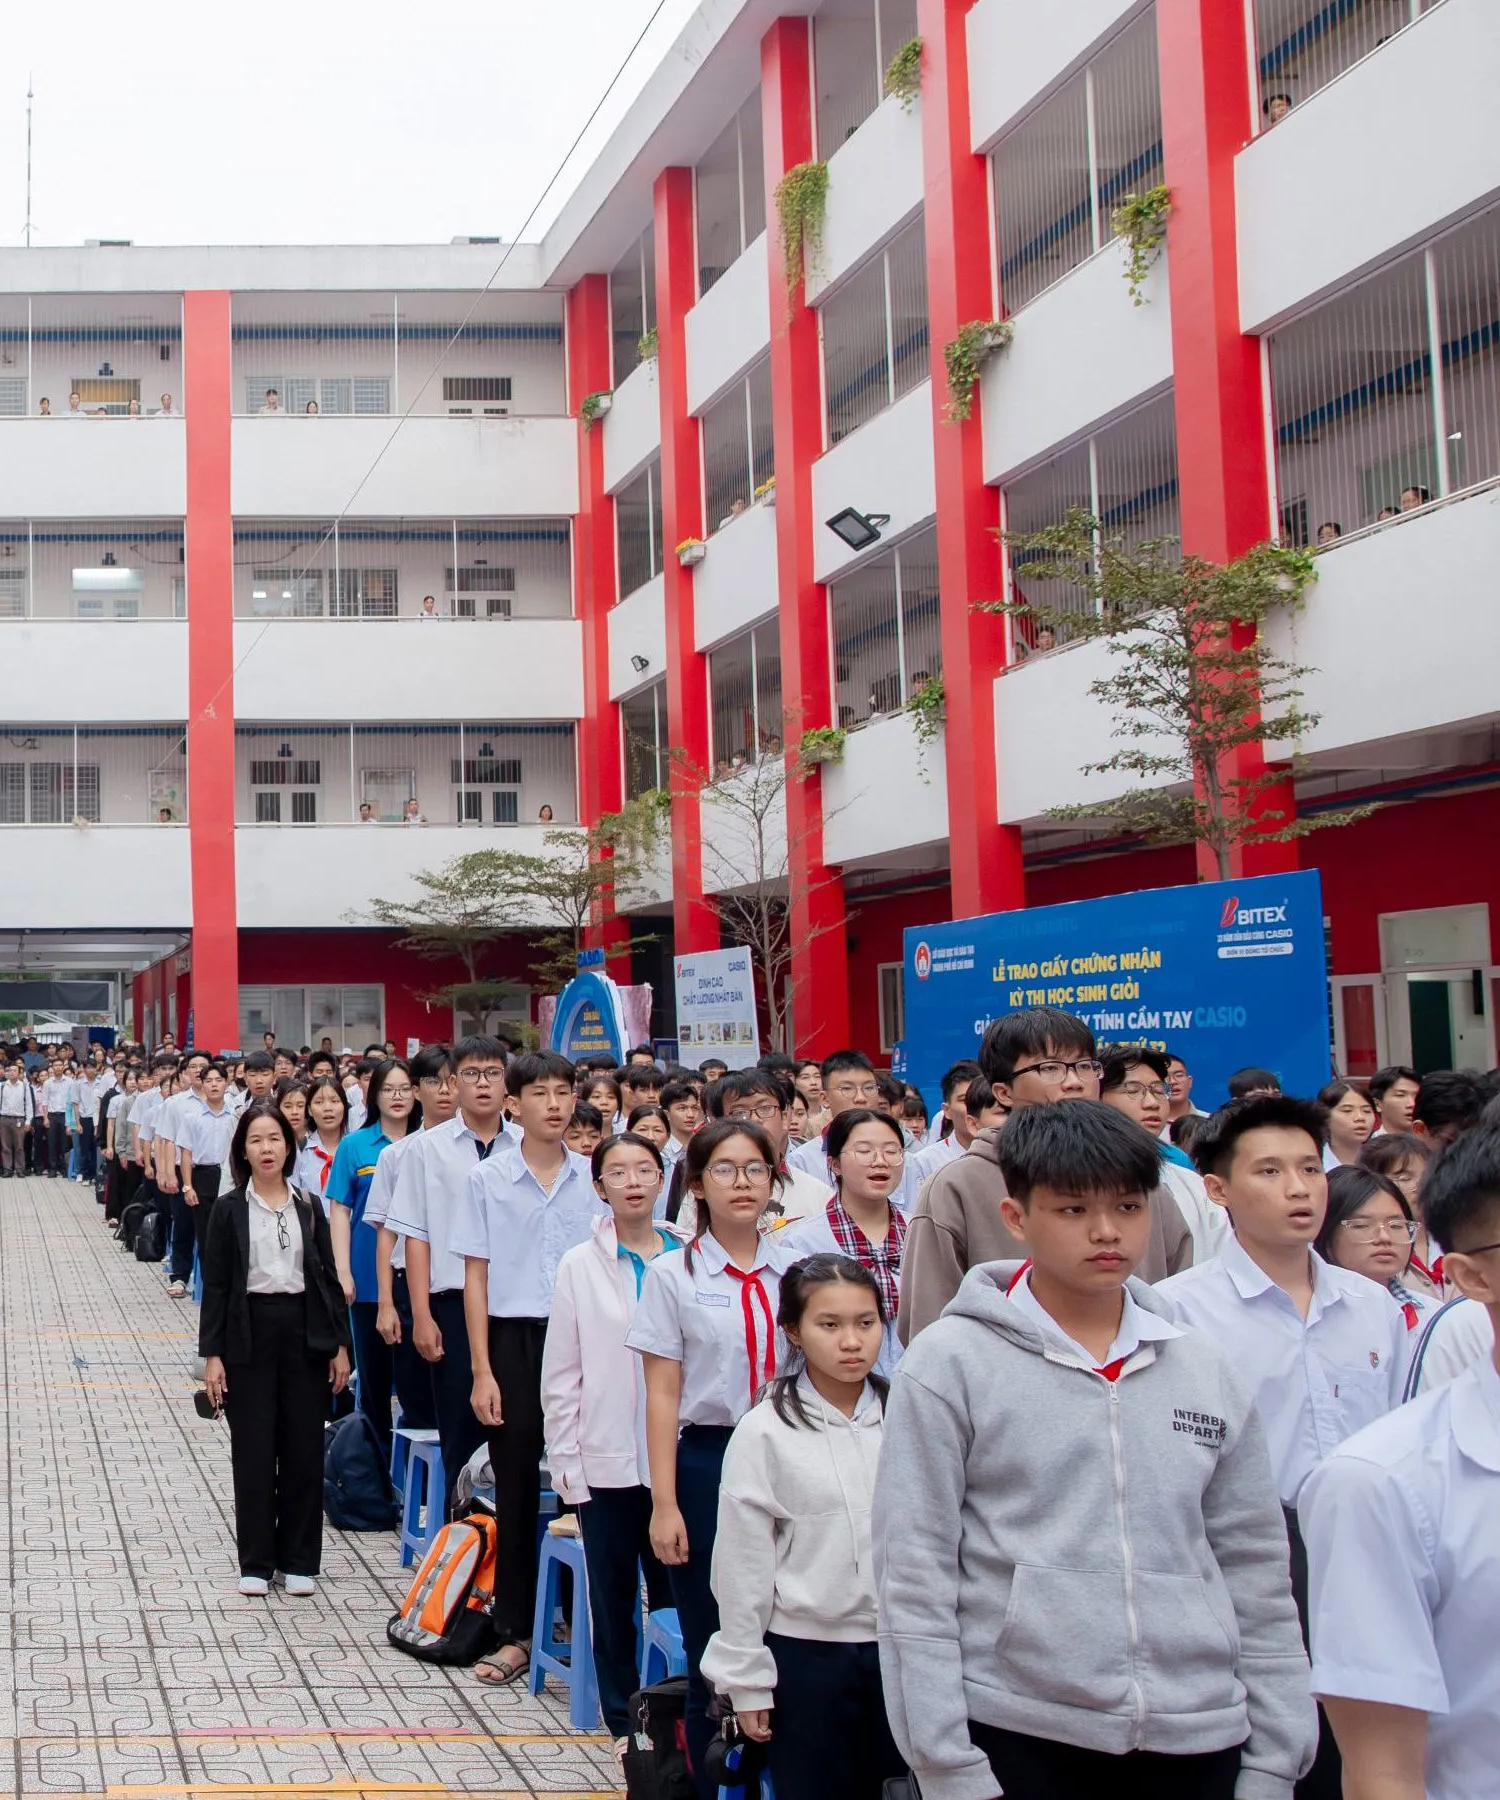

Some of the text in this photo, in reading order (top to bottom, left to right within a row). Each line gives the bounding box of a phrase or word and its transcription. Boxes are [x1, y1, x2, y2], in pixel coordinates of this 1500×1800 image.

[1238, 905, 1287, 926] BITEX
[1266, 928, 1293, 939] CASIO
[728, 960, 746, 972] CASIO
[992, 946, 1162, 982] LỄ TRAO GIẤY CHỨNG NHẬN
[1009, 975, 1140, 1008] KỲ THI HỌC SINH GIỎI
[1093, 1009, 1124, 1031] TÍNH
[1128, 1005, 1160, 1030] CẦM
[1163, 1010, 1192, 1028] TAY
[1195, 1006, 1246, 1028] CASIO
[1173, 1408, 1227, 1427] INTERB
[1172, 1421, 1227, 1440] DEPART
